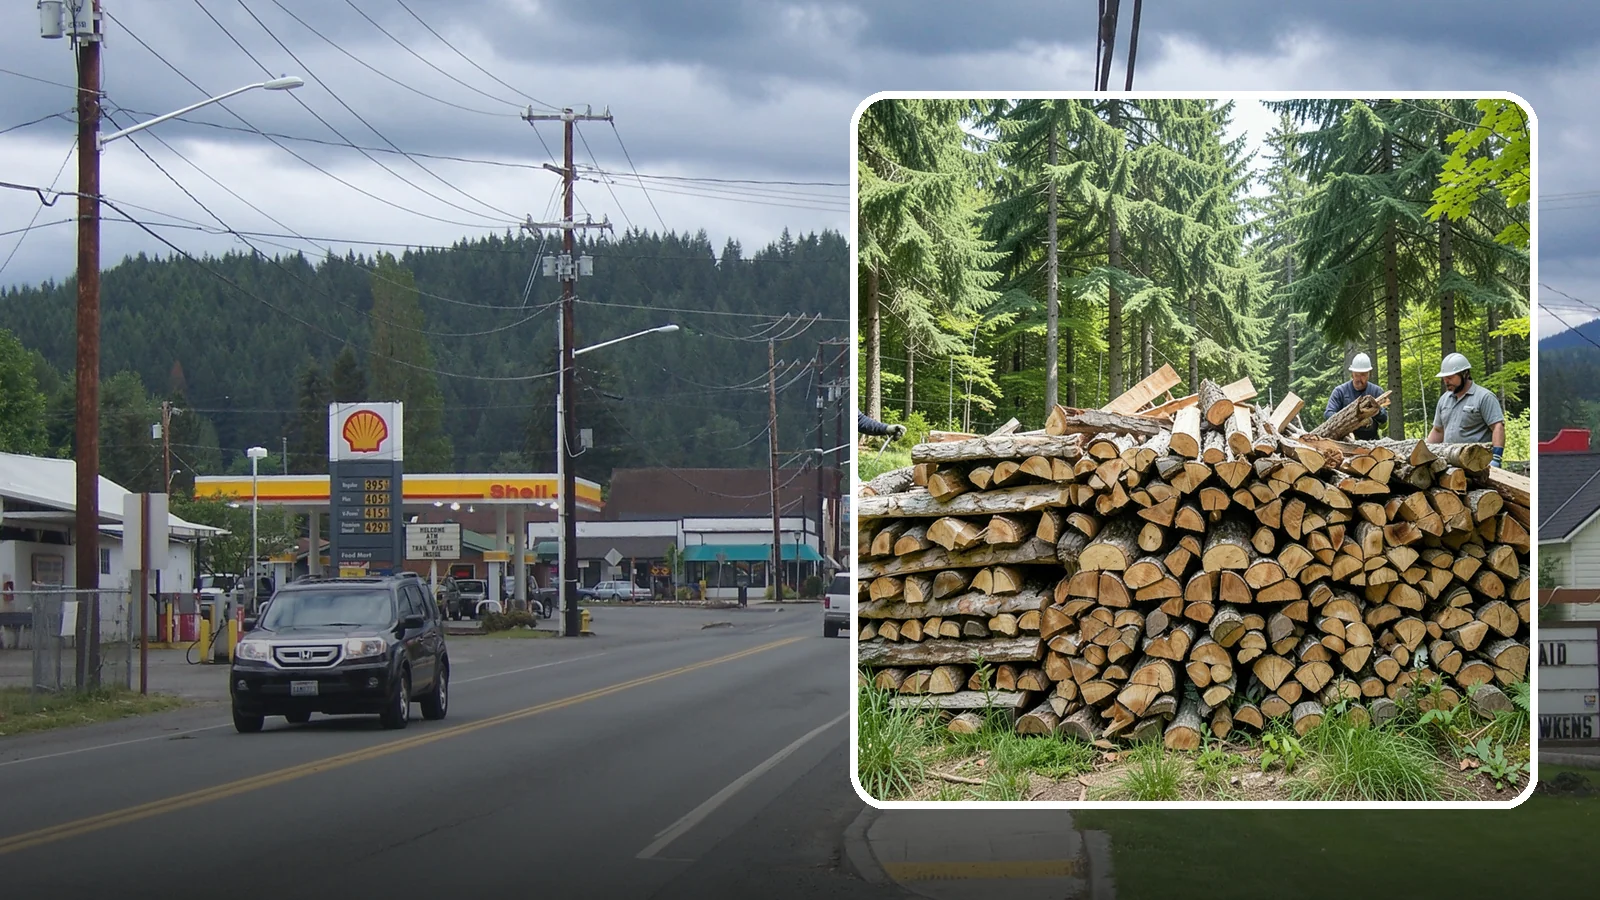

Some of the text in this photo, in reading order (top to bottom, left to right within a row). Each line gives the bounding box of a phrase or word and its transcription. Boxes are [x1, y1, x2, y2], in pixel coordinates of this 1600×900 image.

[366, 480, 384, 490] 395
[489, 484, 547, 499] Shell
[366, 494, 384, 504] 405
[366, 508, 383, 518] 415
[366, 522, 384, 532] 429
[1538, 643, 1566, 665] AID
